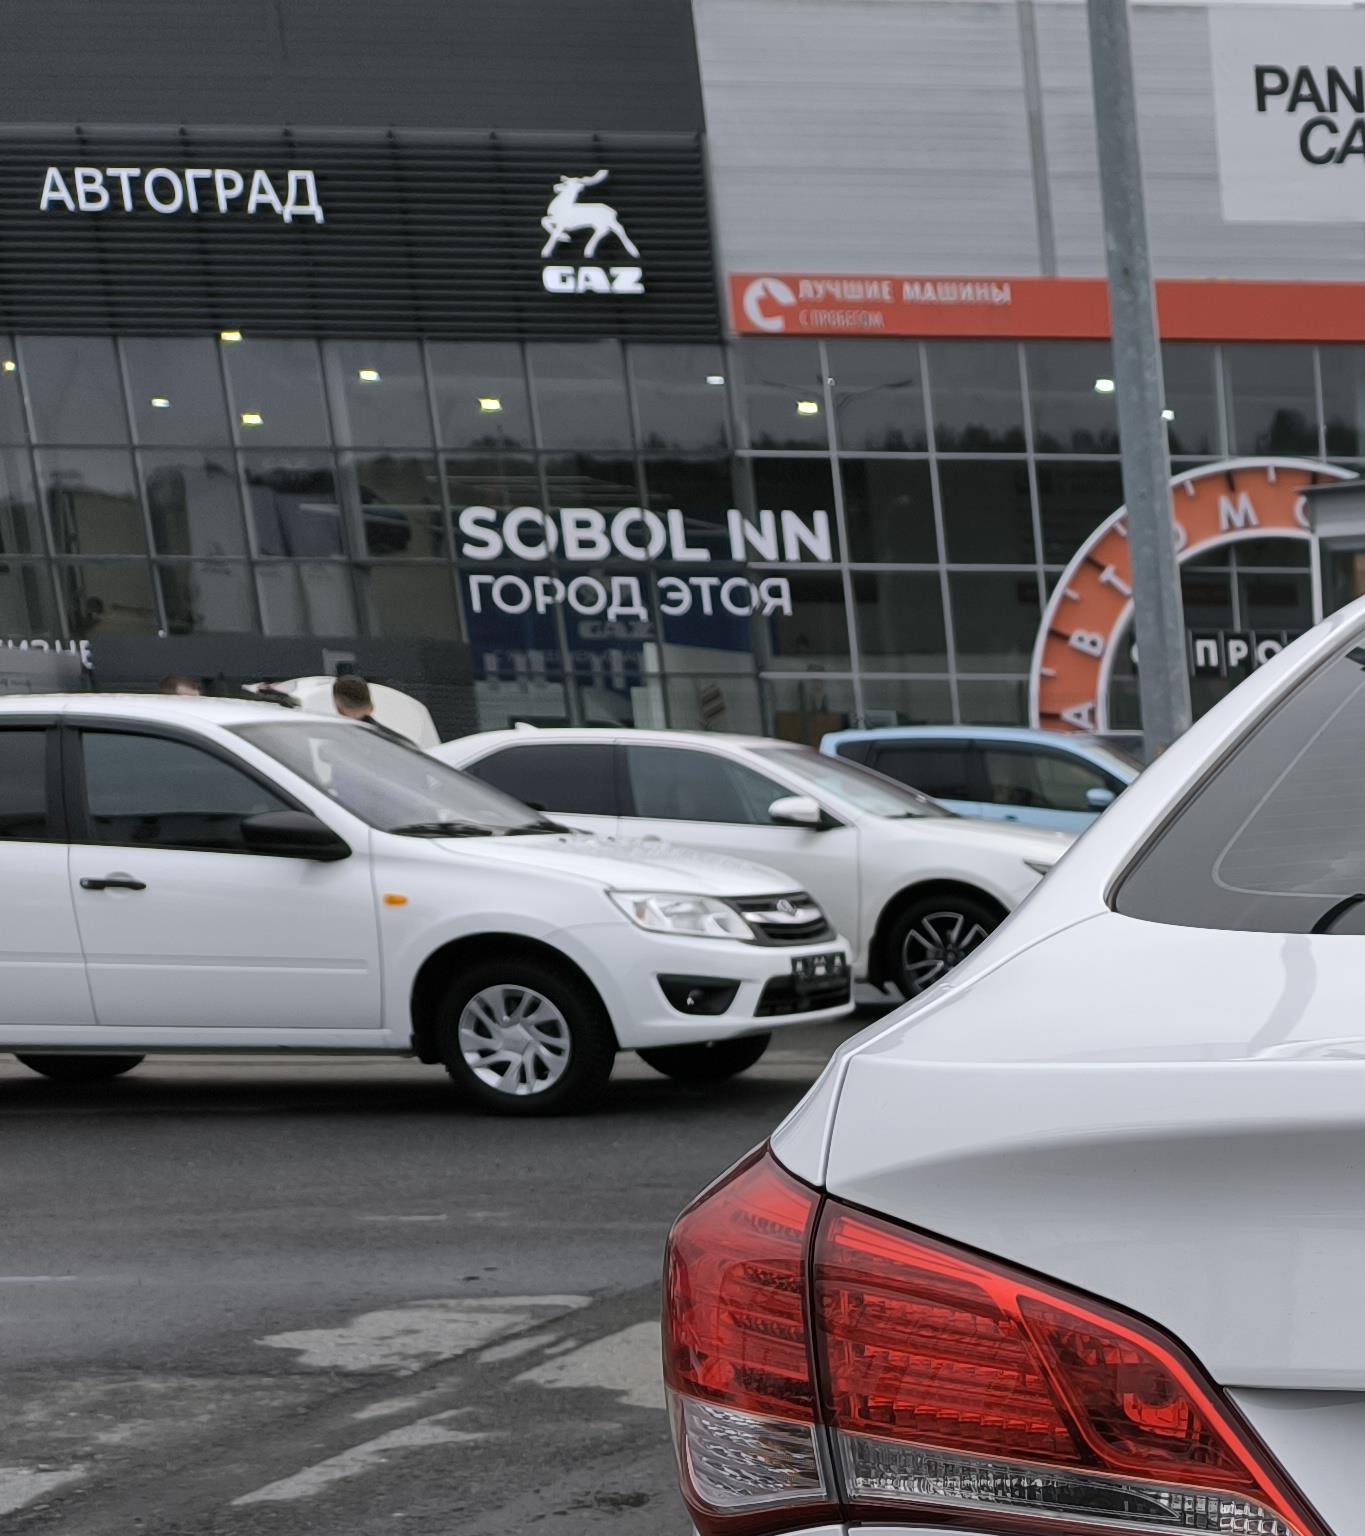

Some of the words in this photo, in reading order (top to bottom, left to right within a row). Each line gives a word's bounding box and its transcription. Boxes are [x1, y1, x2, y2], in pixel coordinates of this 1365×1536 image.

[39, 166, 325, 225] АВТОГРАД
[542, 265, 646, 294] GAZ
[798, 278, 895, 303] ЛУЧШИЕ
[902, 281, 1013, 305] МАШИНЫ
[458, 505, 711, 562] SOBOL
[727, 508, 833, 562] NN
[468, 574, 650, 624] ГОРОД
